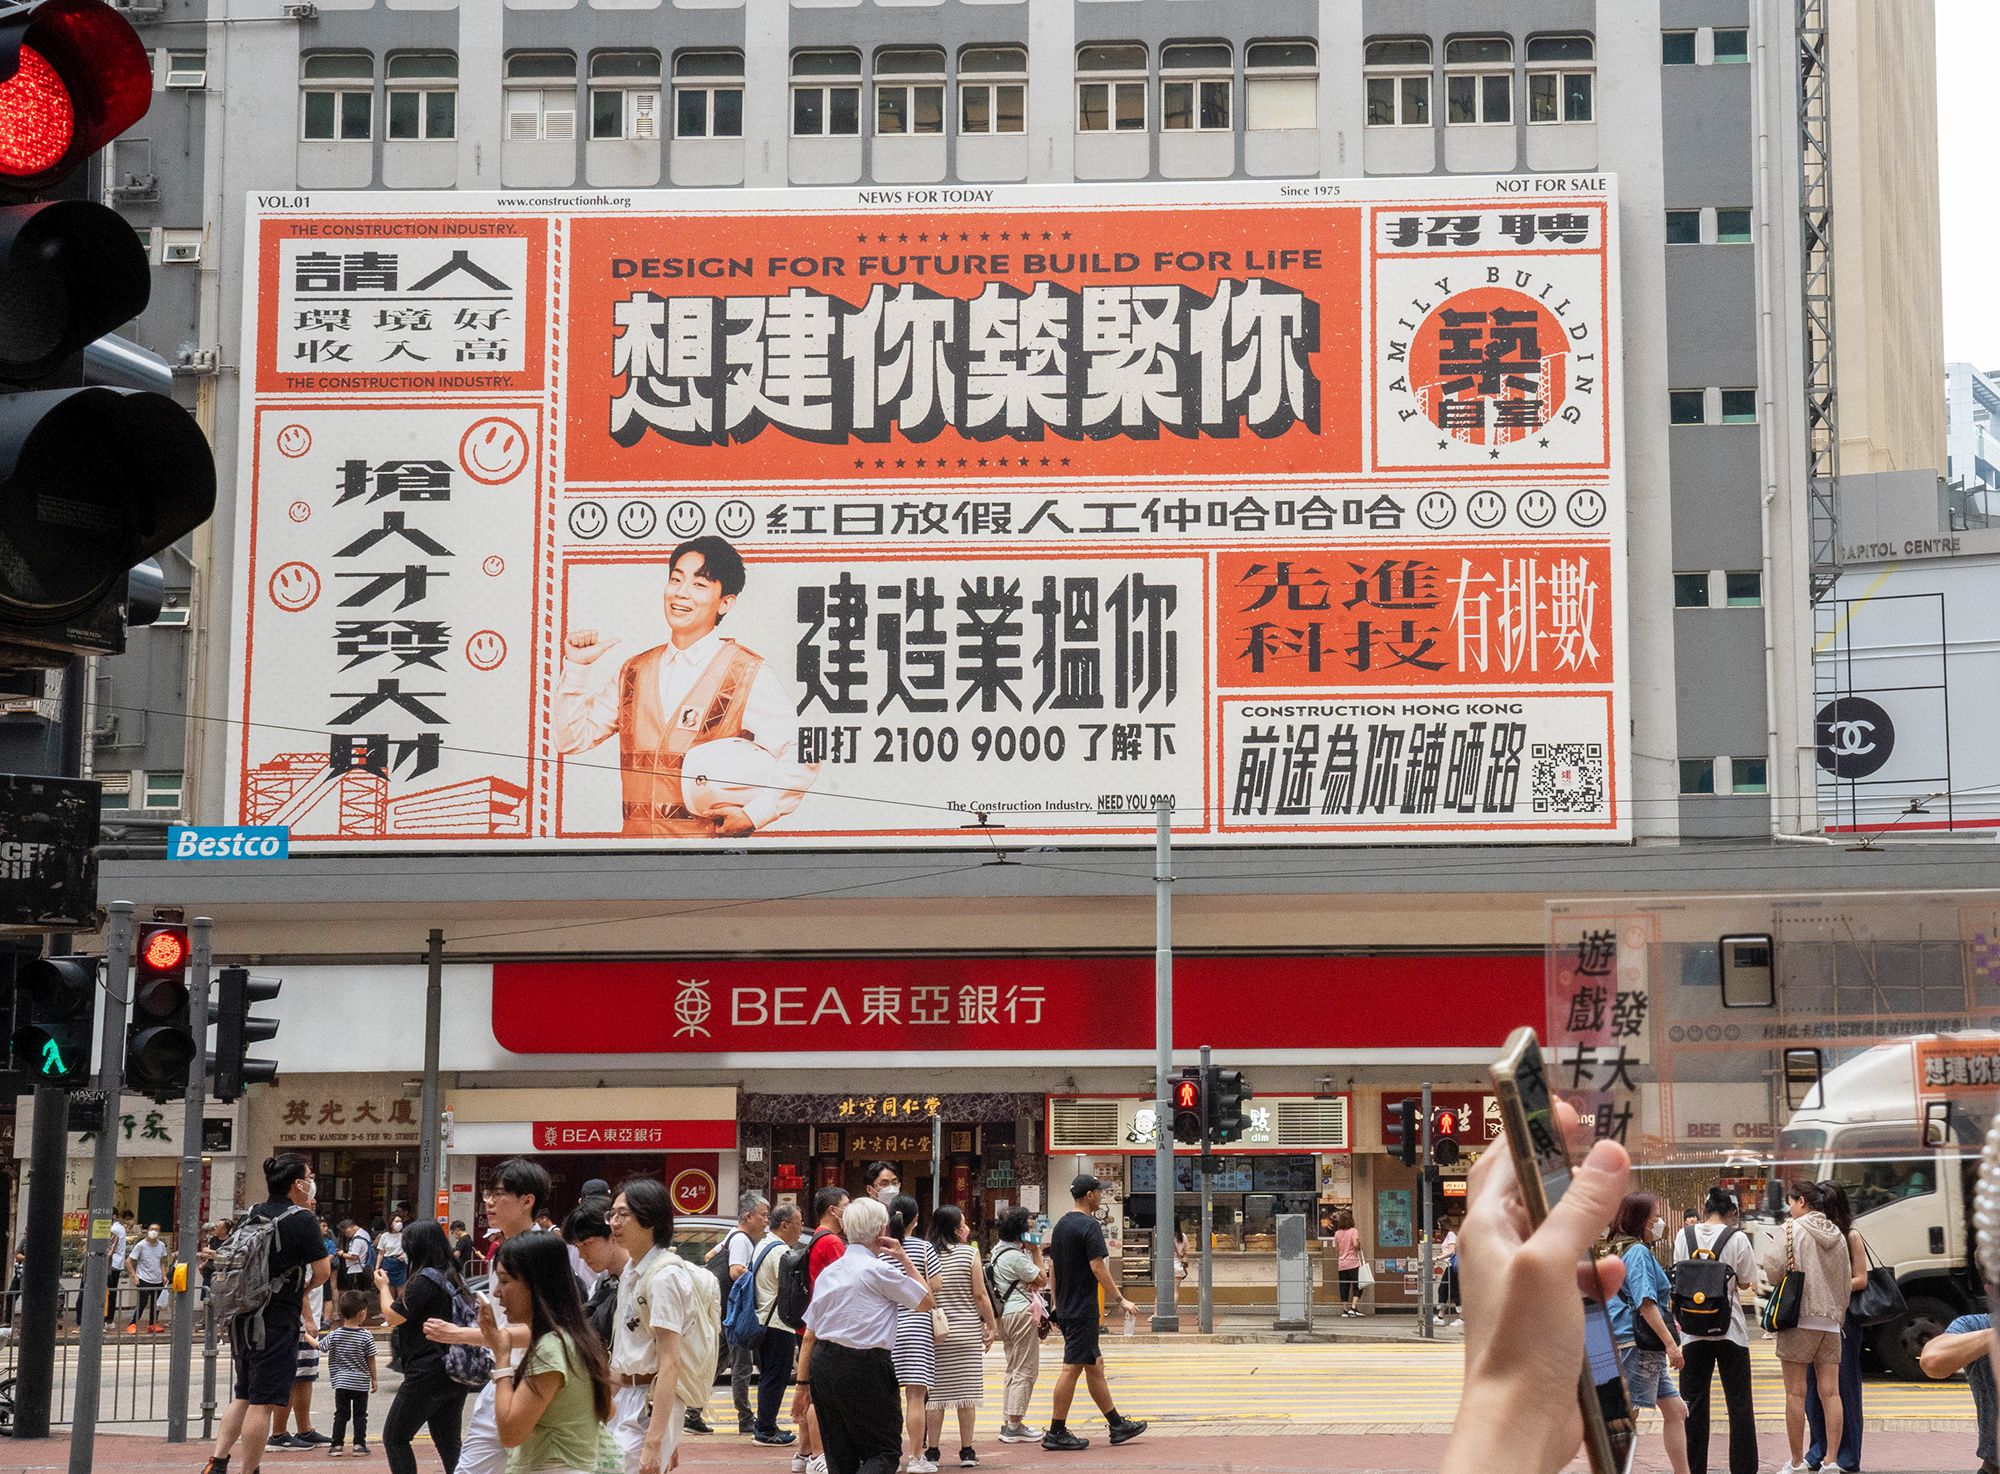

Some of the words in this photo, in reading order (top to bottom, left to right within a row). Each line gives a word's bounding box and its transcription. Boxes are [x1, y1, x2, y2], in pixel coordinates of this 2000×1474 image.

[858, 192, 902, 204] NEWS
[907, 191, 937, 203] FOR
[941, 189, 994, 203] TODAY
[1280, 185, 1310, 197] Since
[1313, 185, 1341, 196] 1975
[1496, 180, 1530, 192] NOT
[1535, 179, 1566, 191] FOR
[1571, 178, 1606, 191] SALE
[258, 196, 310, 208] VOL.01
[497, 195, 631, 207] www.constructionhk.org
[290, 224, 318, 235] THE
[322, 224, 439, 235] CONSTRUCTION
[443, 223, 517, 235] INDUSTRY.
[1385, 213, 1590, 247] 招聘
[296, 250, 513, 291] 請人
[612, 258, 753, 278] DESIGN
[768, 256, 846, 277] FOR
[859, 253, 1010, 276] FUTURE
[1024, 251, 1141, 274] BUILD
[1154, 251, 1232, 271] FOR
[1245, 250, 1322, 270] LIFE
[293, 308, 512, 331] 環境好
[294, 338, 512, 363] 收入高
[1387, 277, 1452, 422] FAMILY
[1486, 266, 1594, 425] BUILDING
[611, 279, 1319, 446] 想建你築緊你
[287, 377, 314, 388] THE
[319, 377, 435, 388] CONSTRUCTION
[439, 376, 513, 387] INDUSTRY.
[767, 494, 1405, 535] 紅日放假人工仲哈哈哈
[1904, 537, 1961, 554] CENTRE
[1234, 560, 1442, 612] 先進
[323, 459, 456, 783] 搶人才發大財
[1446, 555, 1601, 674] 有排數
[1235, 619, 1450, 673] 科技
[1241, 705, 1396, 717] CONSTRUCTION
[1402, 704, 1461, 717] HONG
[1466, 703, 1523, 716] KONG
[797, 726, 862, 763] 即打
[874, 727, 959, 762] 2100
[972, 725, 1066, 762] 9000
[1078, 723, 1177, 761] 了解下
[947, 801, 967, 811] The
[970, 799, 1042, 812] Construction
[1046, 799, 1093, 813] Industry.
[1097, 795, 1123, 810] NEED
[1125, 794, 1147, 810] YOU
[176, 831, 280, 857] Bestco
[731, 987, 853, 1026] BEA
[861, 984, 1047, 1026] 東亞銀行
[1563, 928, 1617, 1090] 遊戲卡
[282, 1099, 417, 1125] 英光大廈
[838, 1097, 942, 1117] 北京同仁堂
[562, 1129, 602, 1142] BEA
[603, 1128, 663, 1142] 東亞銀行
[1251, 1134, 1270, 1143] dim
[1687, 1123, 1721, 1138] BEE
[852, 1135, 931, 1152] 北京同仁堂
